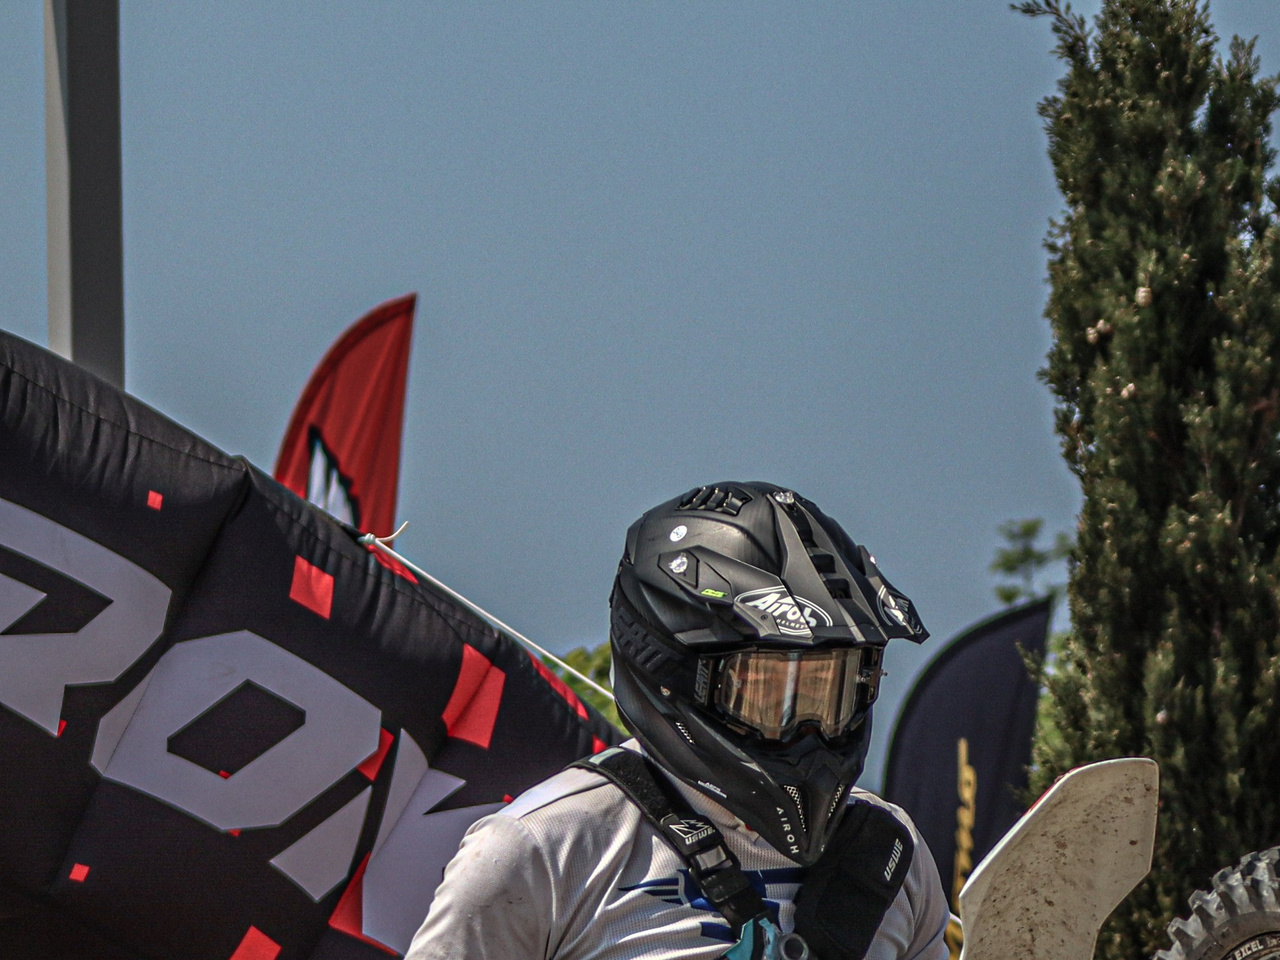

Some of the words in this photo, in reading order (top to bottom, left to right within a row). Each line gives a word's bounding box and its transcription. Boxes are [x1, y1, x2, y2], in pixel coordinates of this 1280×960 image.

[685, 826, 714, 845] USWE
[776, 806, 799, 854] AIROH
[884, 838, 903, 881] USWE
